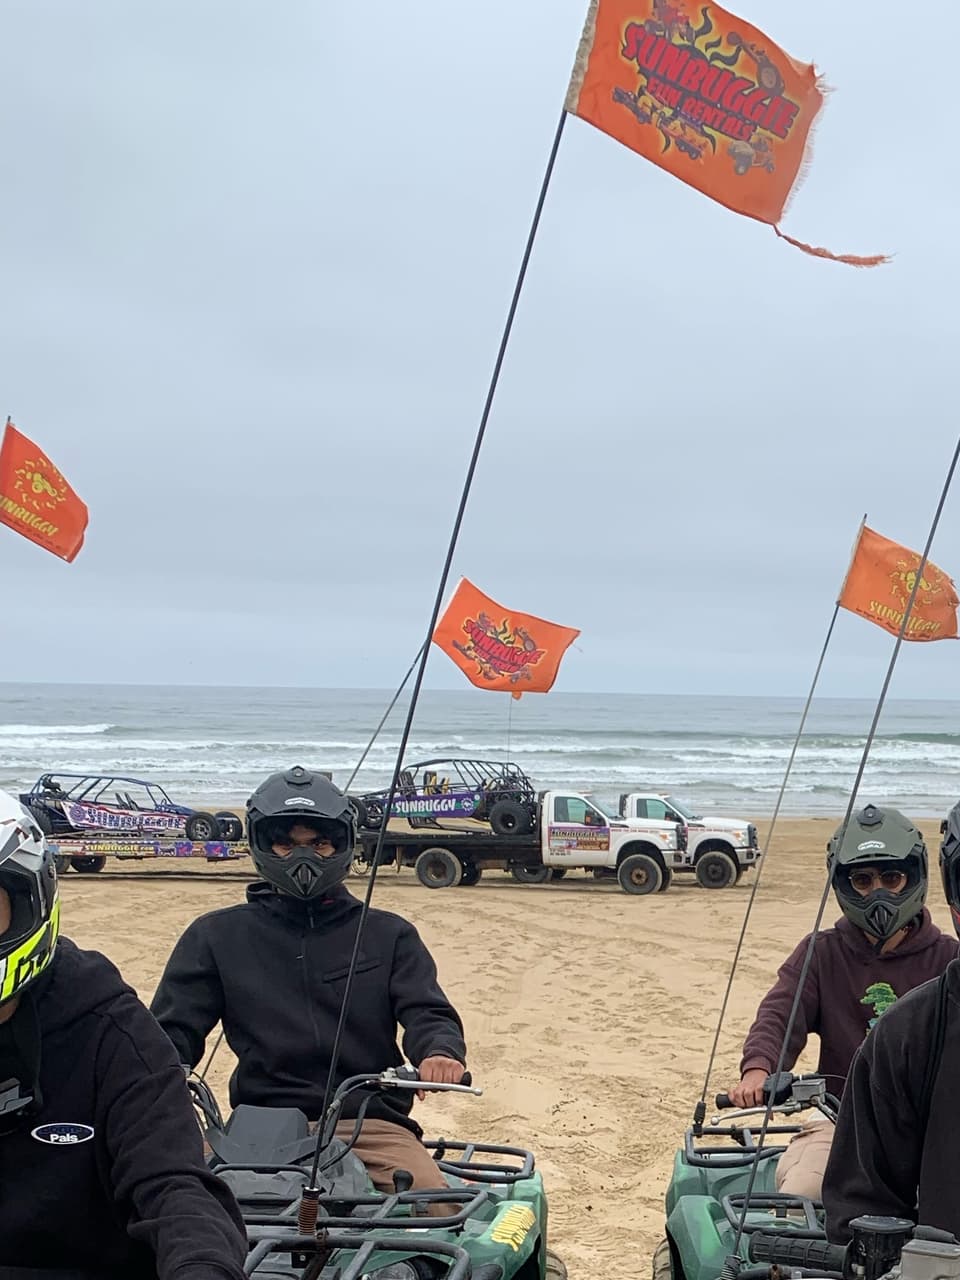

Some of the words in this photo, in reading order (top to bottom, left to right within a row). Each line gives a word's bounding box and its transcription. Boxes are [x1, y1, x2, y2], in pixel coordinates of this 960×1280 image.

[622, 22, 800, 139] SUNBUGGIE
[647, 77, 682, 107] FUN
[680, 96, 755, 141] RENTALS
[395, 799, 456, 813] SUNBUGGY
[50, 1133, 78, 1142] Pals
